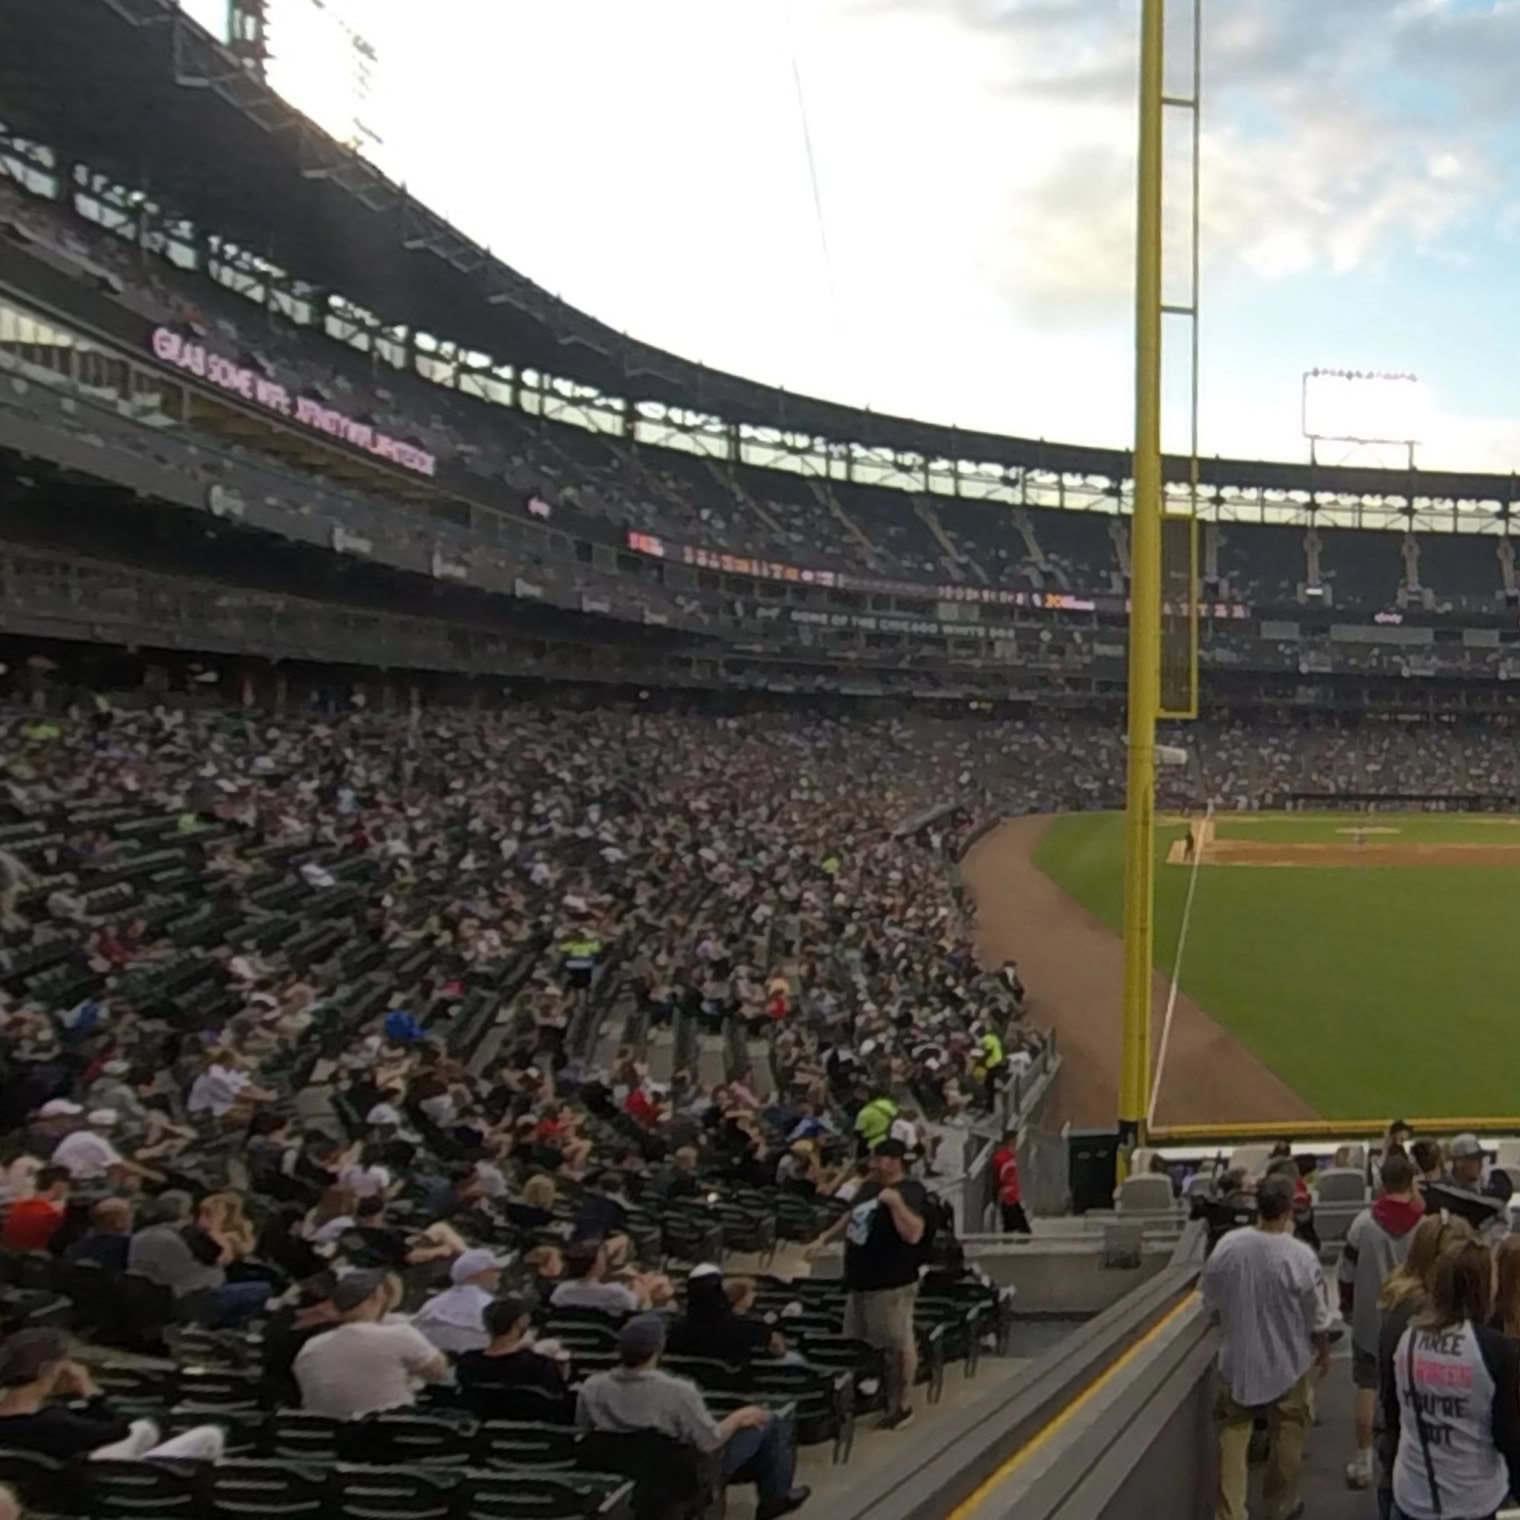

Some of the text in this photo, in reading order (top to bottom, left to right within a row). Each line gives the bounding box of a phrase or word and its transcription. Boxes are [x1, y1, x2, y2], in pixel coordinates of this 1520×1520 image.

[207, 353, 254, 399] SOME
[831, 614, 848, 626] OF
[851, 616, 876, 629] THE
[879, 619, 938, 634] CHICAGO
[942, 625, 985, 638] WHITE
